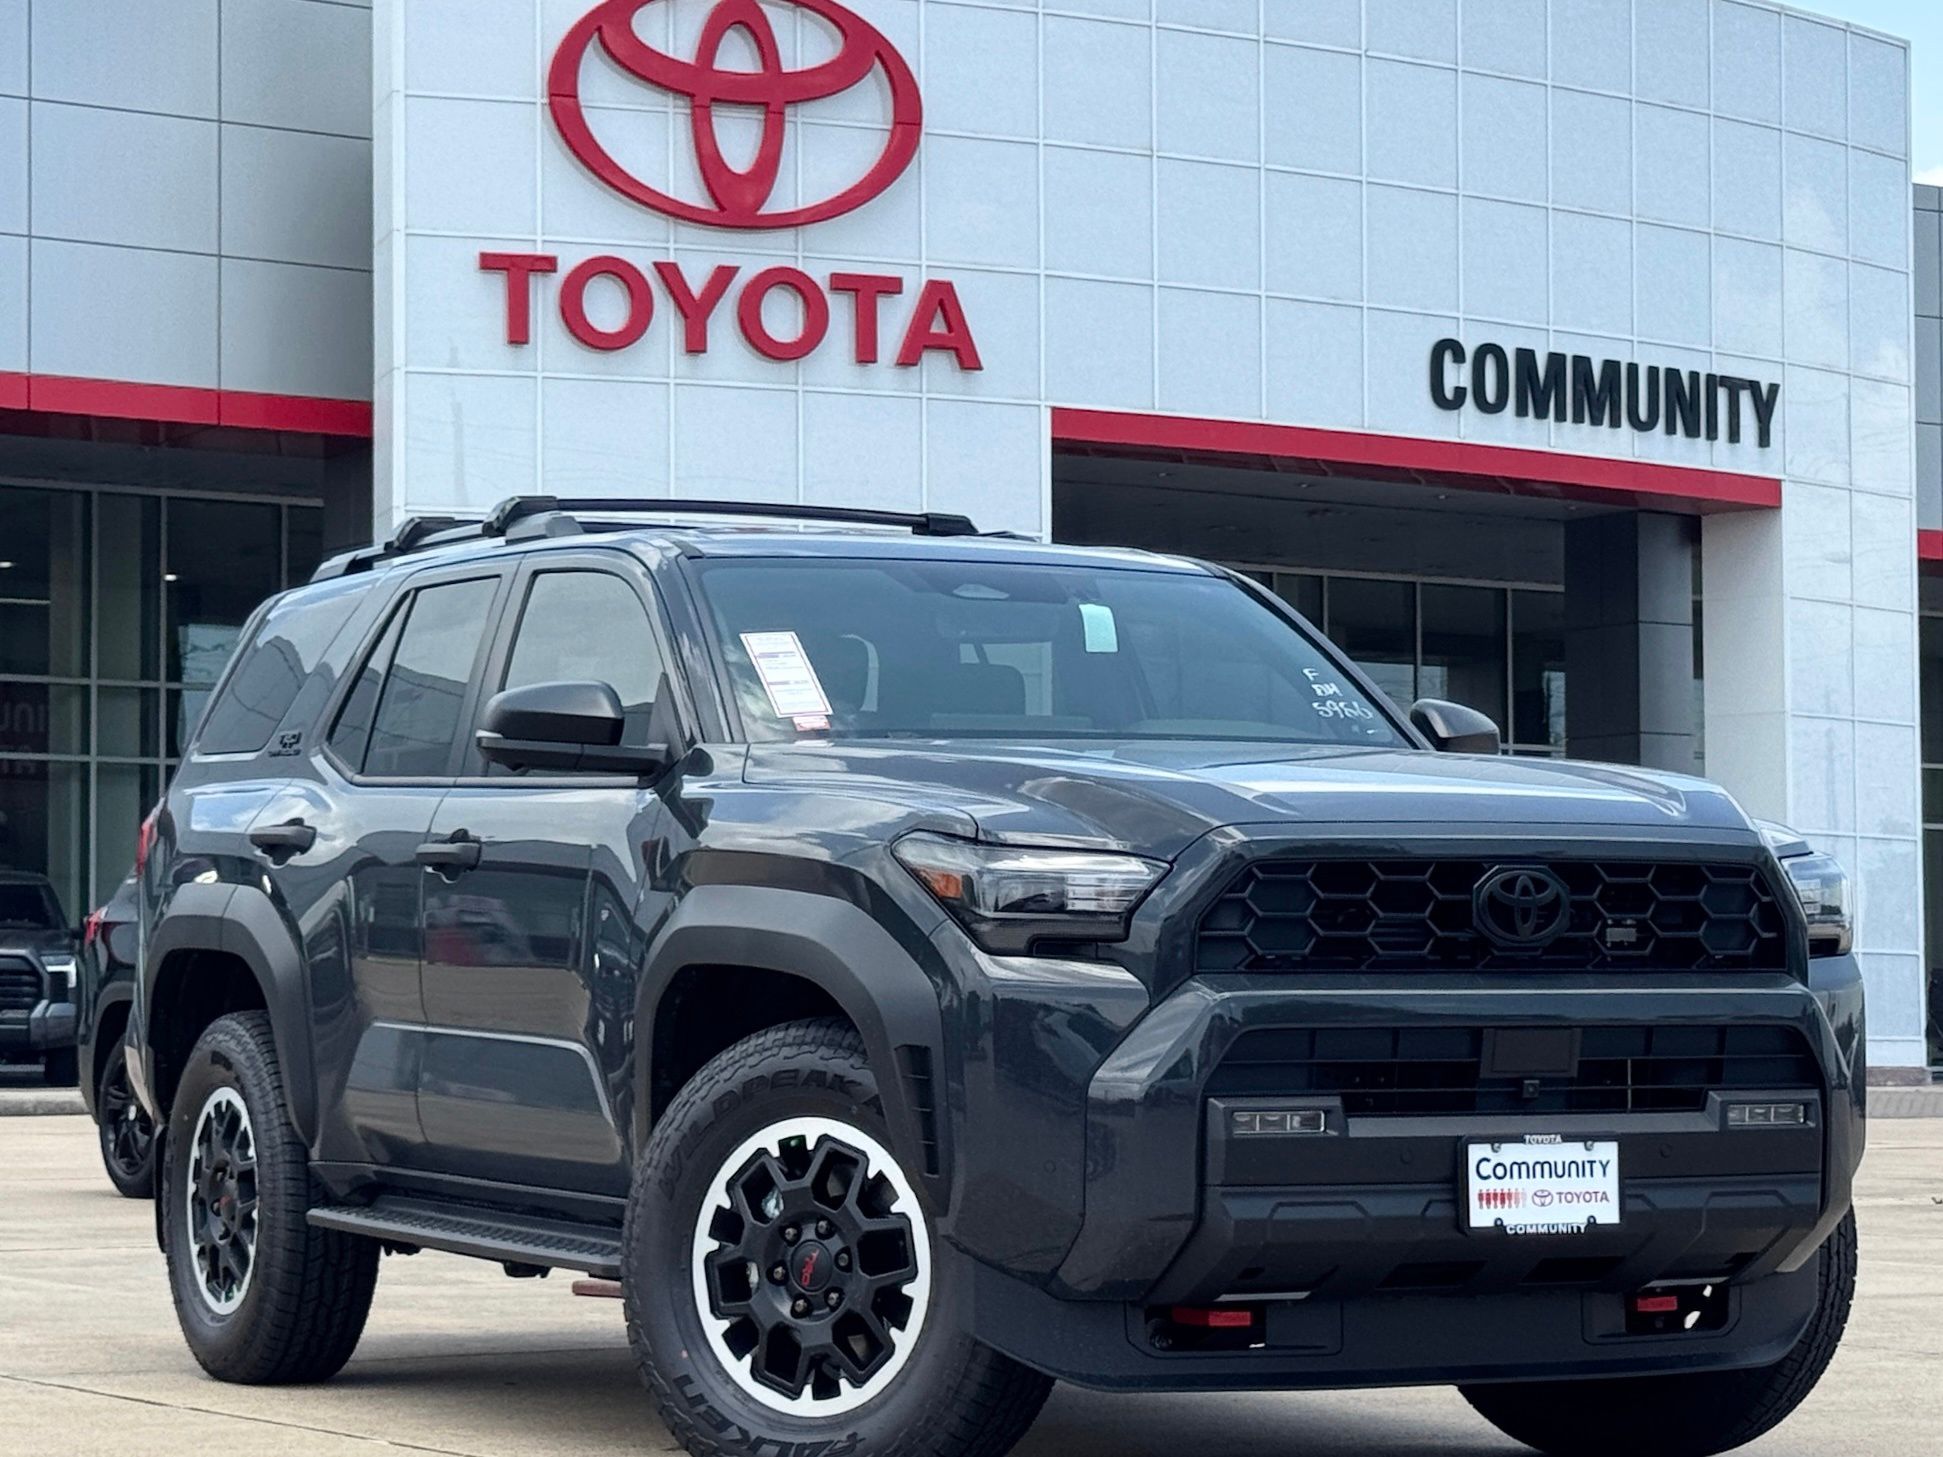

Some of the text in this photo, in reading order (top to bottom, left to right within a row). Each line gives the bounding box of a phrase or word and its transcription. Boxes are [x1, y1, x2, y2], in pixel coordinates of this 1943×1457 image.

[479, 251, 984, 371] TOYOTA
[1429, 338, 1780, 448] COMMUNITY
[1523, 1134, 1563, 1145] TOYOTA
[1556, 1191, 1611, 1204] TOYOTA
[1505, 1223, 1587, 1236] COMMUNITY
